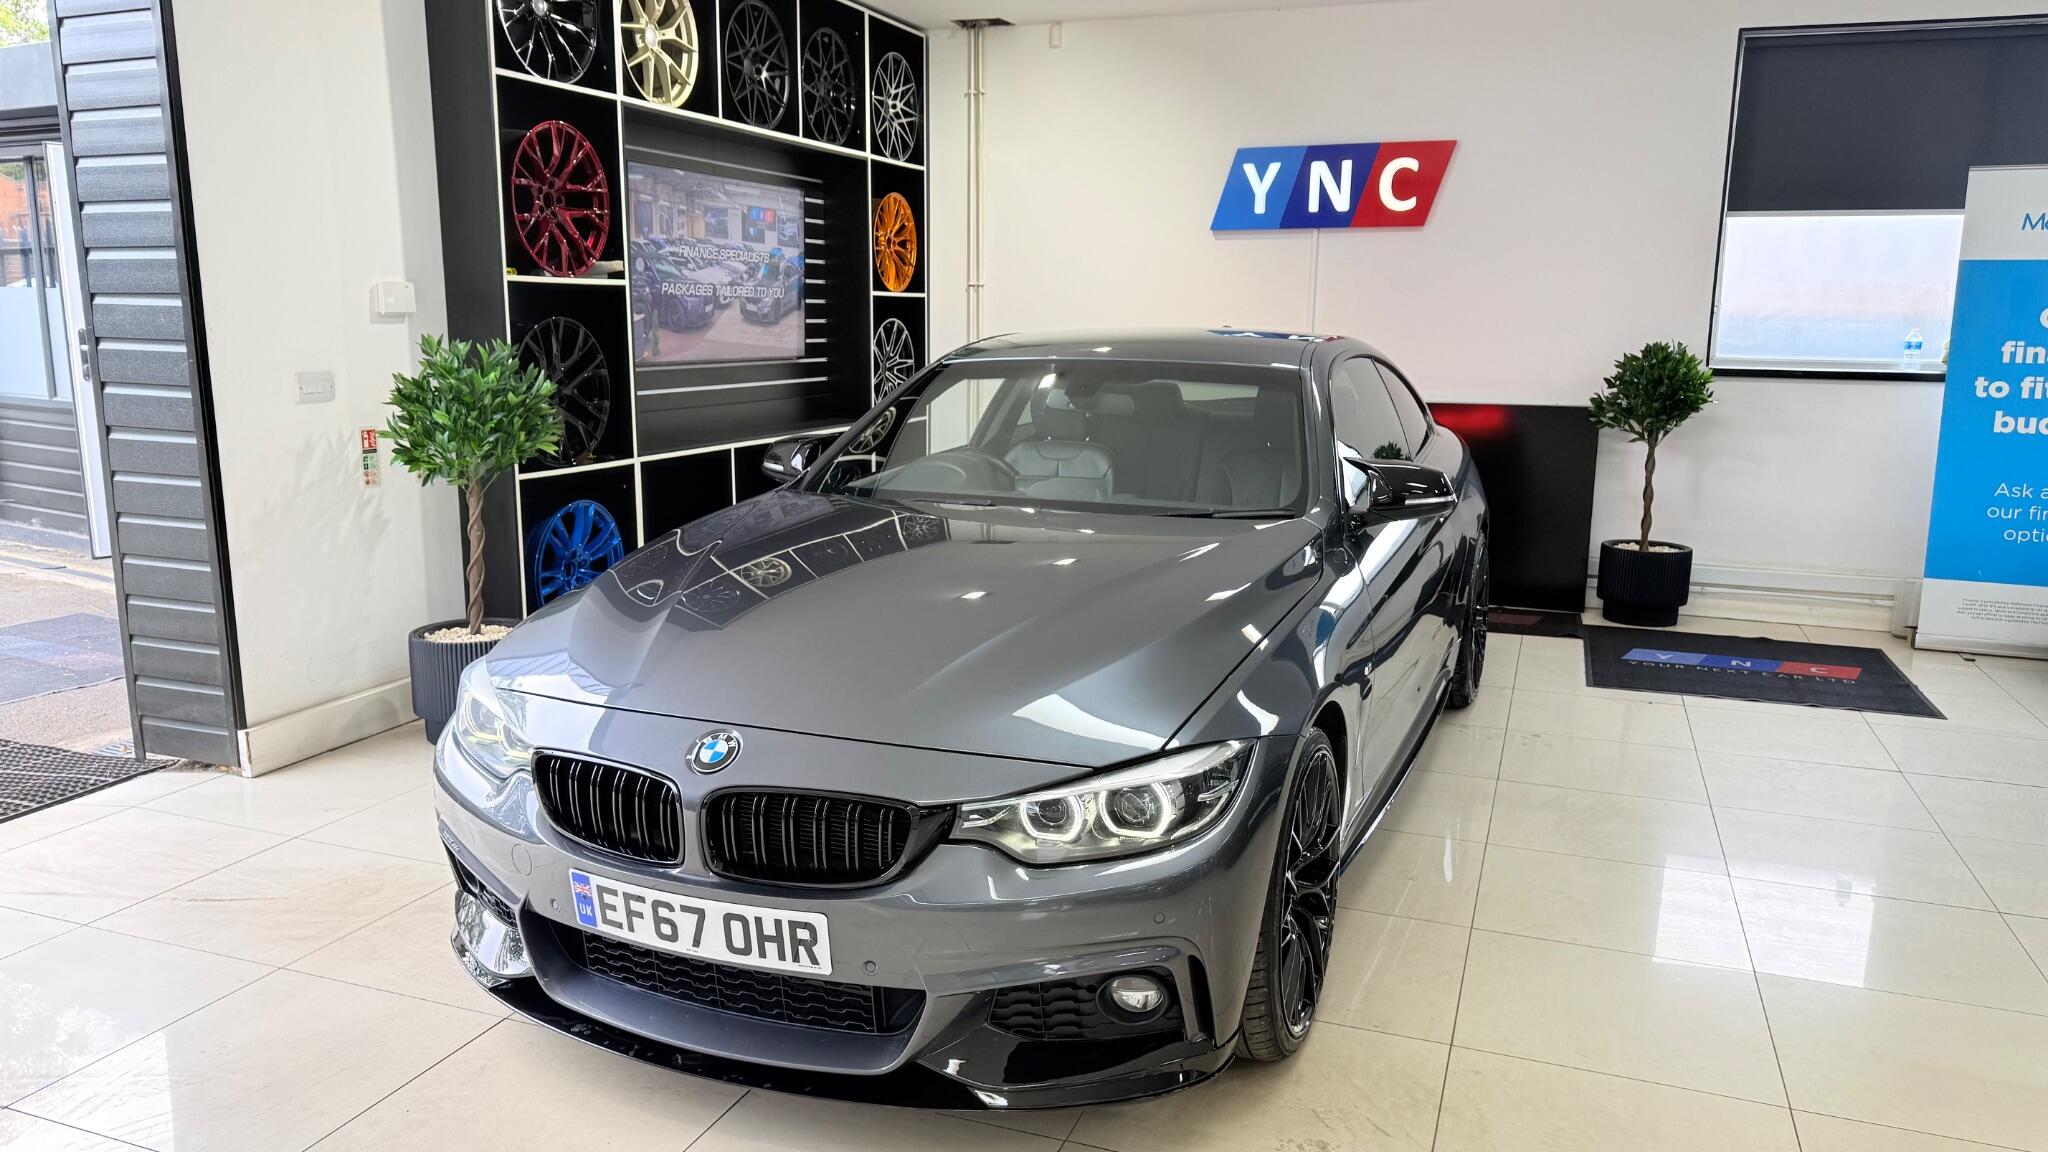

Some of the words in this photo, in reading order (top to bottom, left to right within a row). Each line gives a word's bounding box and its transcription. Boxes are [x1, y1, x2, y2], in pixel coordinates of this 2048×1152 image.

[679, 245, 719, 260] FINANCE
[719, 248, 770, 263] SPECIALISTS
[661, 282, 714, 297] PACKAGES
[716, 285, 755, 298] TAILORED
[756, 286, 768, 298] TO
[769, 287, 785, 299] YOU
[2001, 340, 2048, 365] fin
[1974, 376, 2010, 399] to
[2020, 375, 2048, 400] fi
[1994, 482, 2033, 499] Ask
[1986, 506, 2022, 520] our
[2003, 527, 2048, 545] opti
[1628, 660, 1685, 670] YOUR
[1696, 665, 1749, 675] NEXT
[1761, 671, 1802, 680] CAR
[1816, 676, 1856, 684] LTD
[579, 902, 593, 918] UK
[595, 883, 706, 949] EF67
[722, 911, 821, 967] OHR
